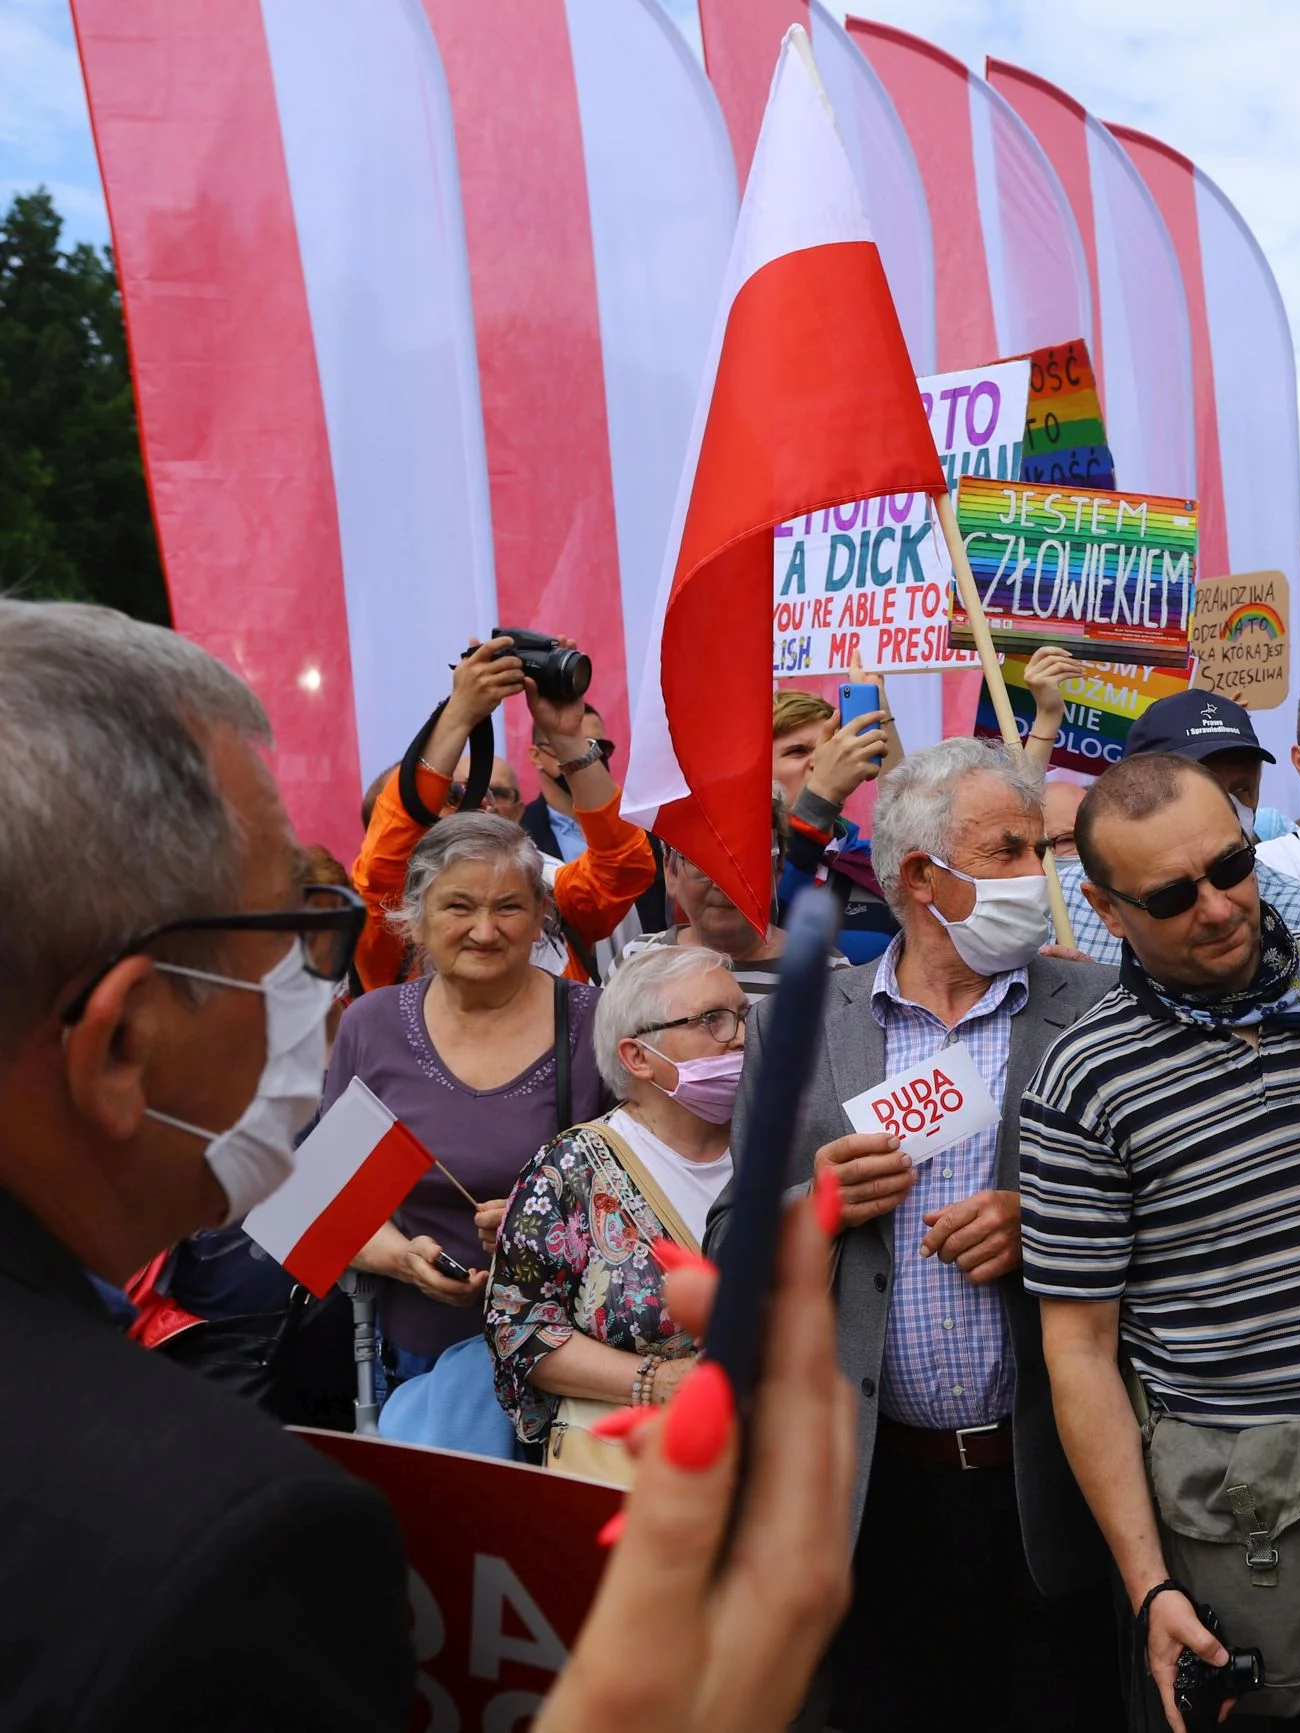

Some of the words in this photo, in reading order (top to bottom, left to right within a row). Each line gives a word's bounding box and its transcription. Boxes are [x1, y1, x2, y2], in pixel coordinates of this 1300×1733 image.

[940, 380, 1001, 450] TO
[1025, 411, 1060, 450] TO
[999, 488, 1148, 538] JESTEM
[780, 540, 806, 596] A
[825, 521, 936, 593] DICK
[956, 531, 1191, 632] CZŁOWIEKIEM
[838, 587, 897, 629] ABLE
[905, 582, 941, 622] TO
[1194, 581, 1276, 618] PRAWDZIWA
[1248, 616, 1270, 634] TO
[1263, 643, 1285, 663] JEST
[1063, 703, 1103, 731] NIE
[1202, 719, 1224, 727] Prawo
[871, 1068, 955, 1124] DUDA
[884, 1088, 964, 1142] 2020
